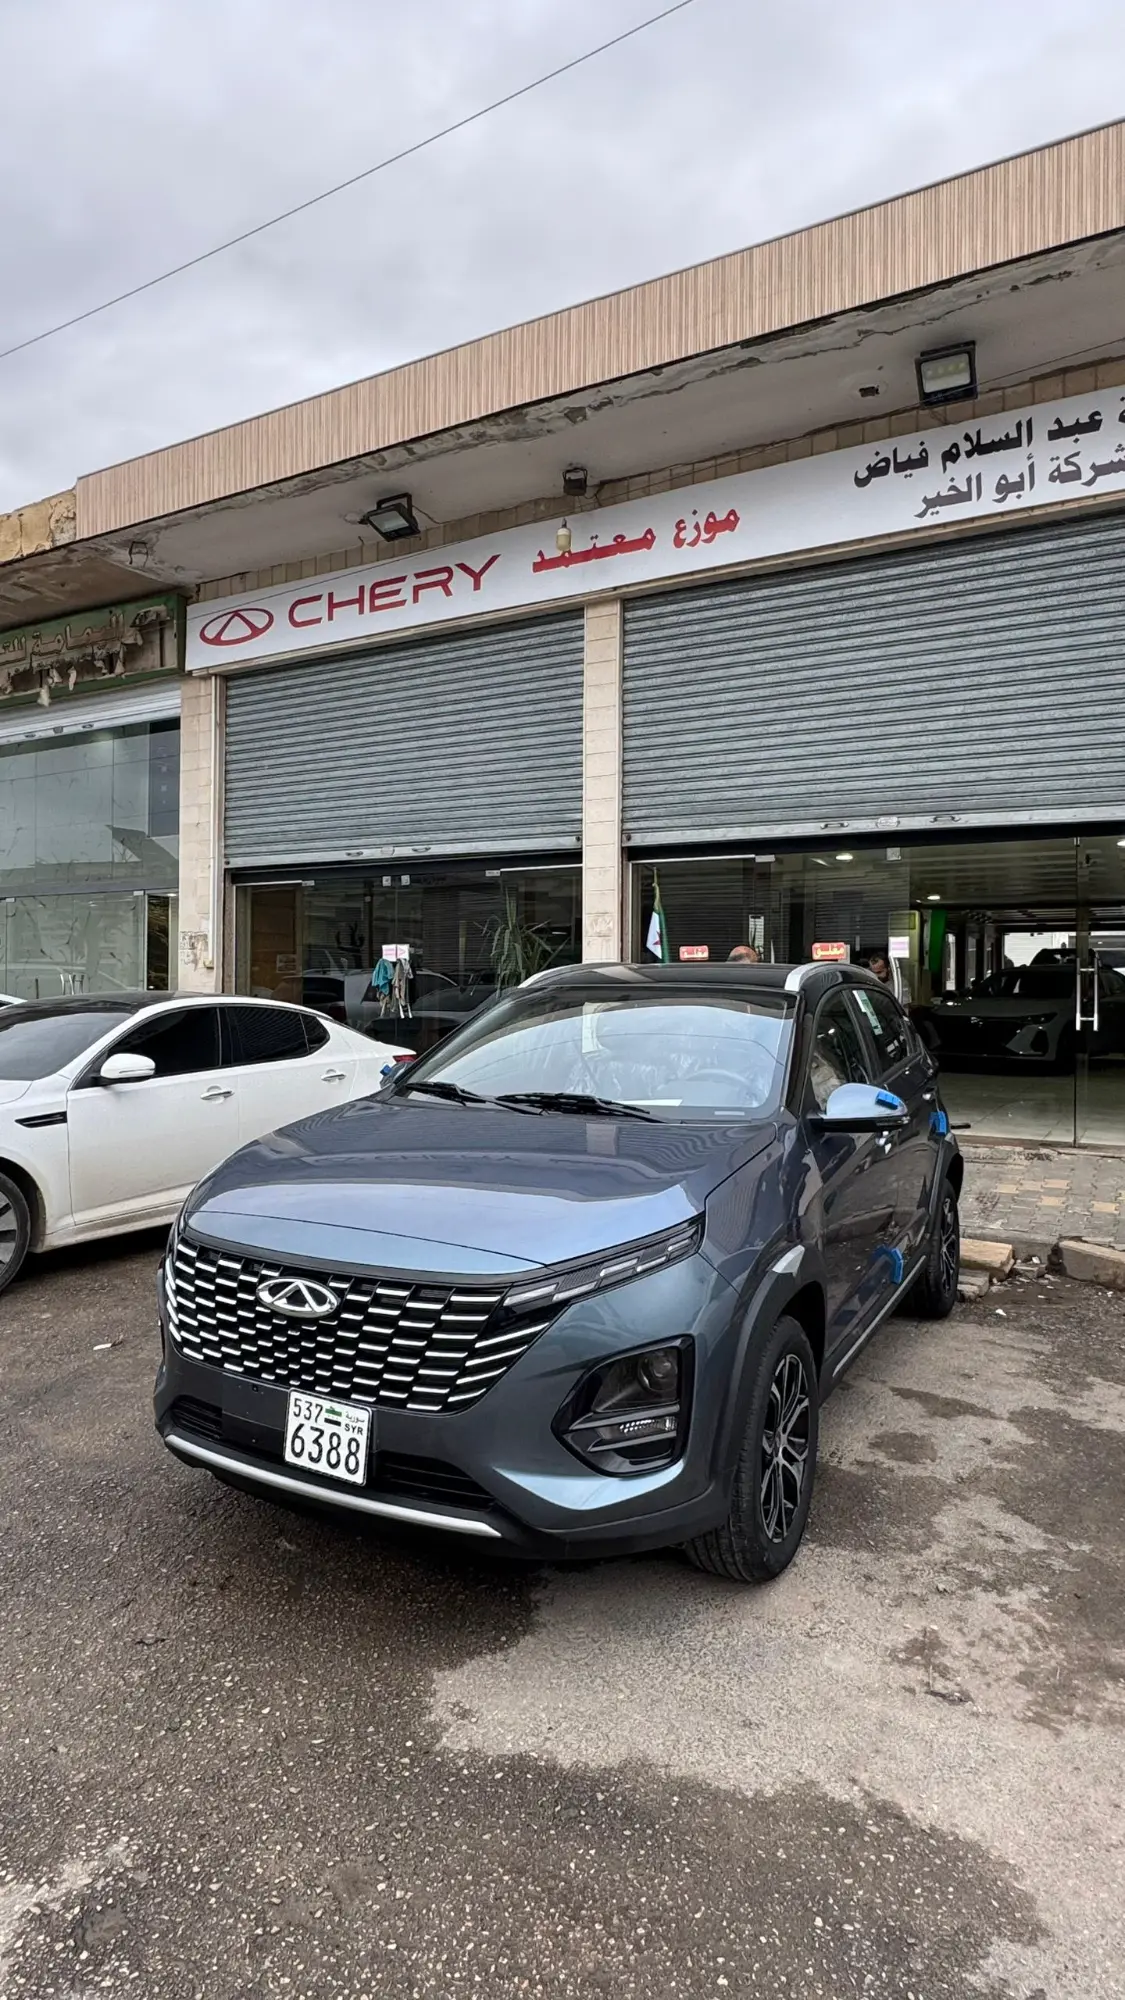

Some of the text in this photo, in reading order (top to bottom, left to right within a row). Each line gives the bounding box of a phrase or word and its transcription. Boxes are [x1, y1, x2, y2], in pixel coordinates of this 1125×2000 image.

[854, 411, 1103, 488] عبد السلام فياض
[914, 472, 982, 519] الخير
[992, 452, 1035, 504] أبو
[532, 508, 740, 573] موزع معتمد
[288, 553, 502, 629] CHERY
[814, 943, 845, 959] مغلق
[293, 1397, 324, 1424] 537
[344, 1423, 364, 1436] SYR
[290, 1423, 360, 1476] 6388
